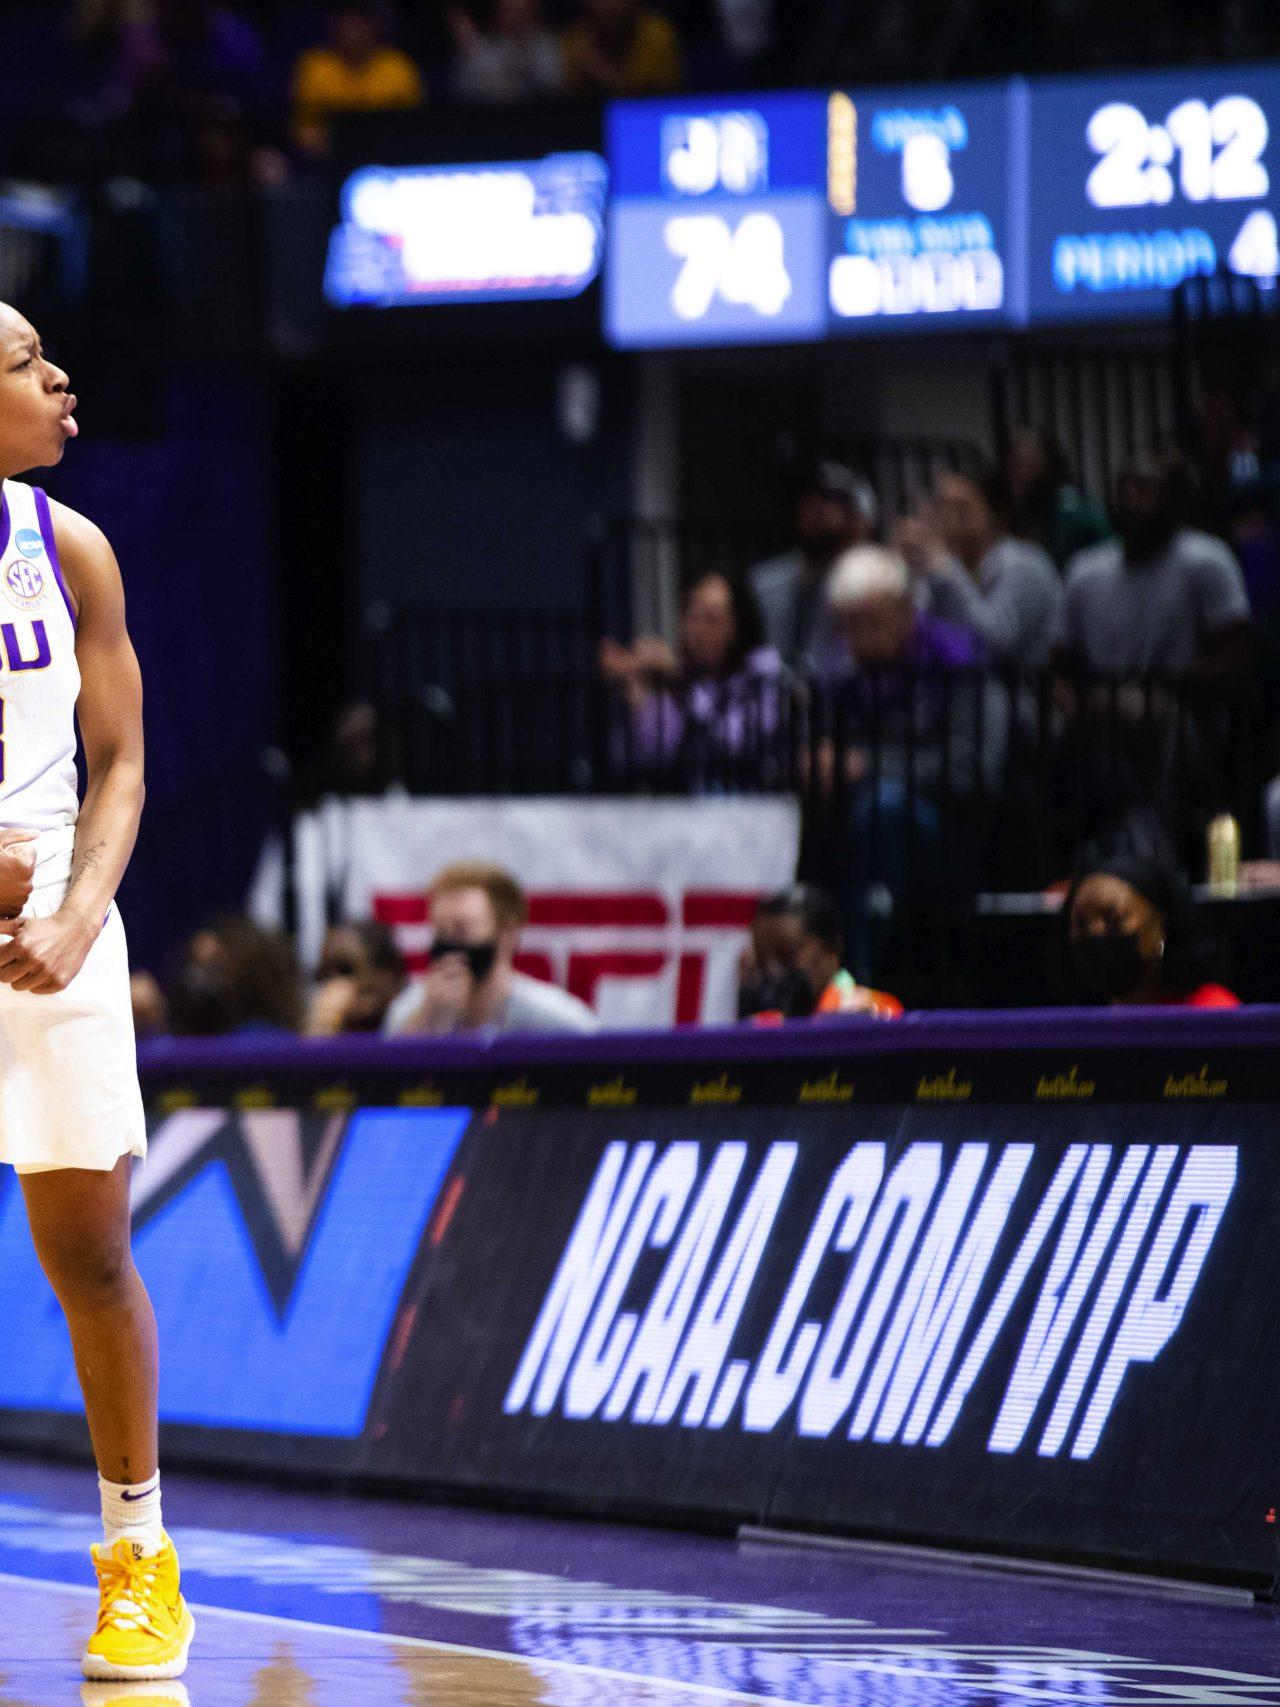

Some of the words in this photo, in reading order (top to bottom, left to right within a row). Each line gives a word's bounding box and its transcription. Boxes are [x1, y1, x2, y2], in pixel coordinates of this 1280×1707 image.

[1084, 97, 1269, 207] 2:12
[664, 212, 792, 319] 74
[1228, 208, 1280, 290] 4
[7, 561, 43, 597] SEC
[504, 1141, 1238, 1459] NCAA.COM/VIP
